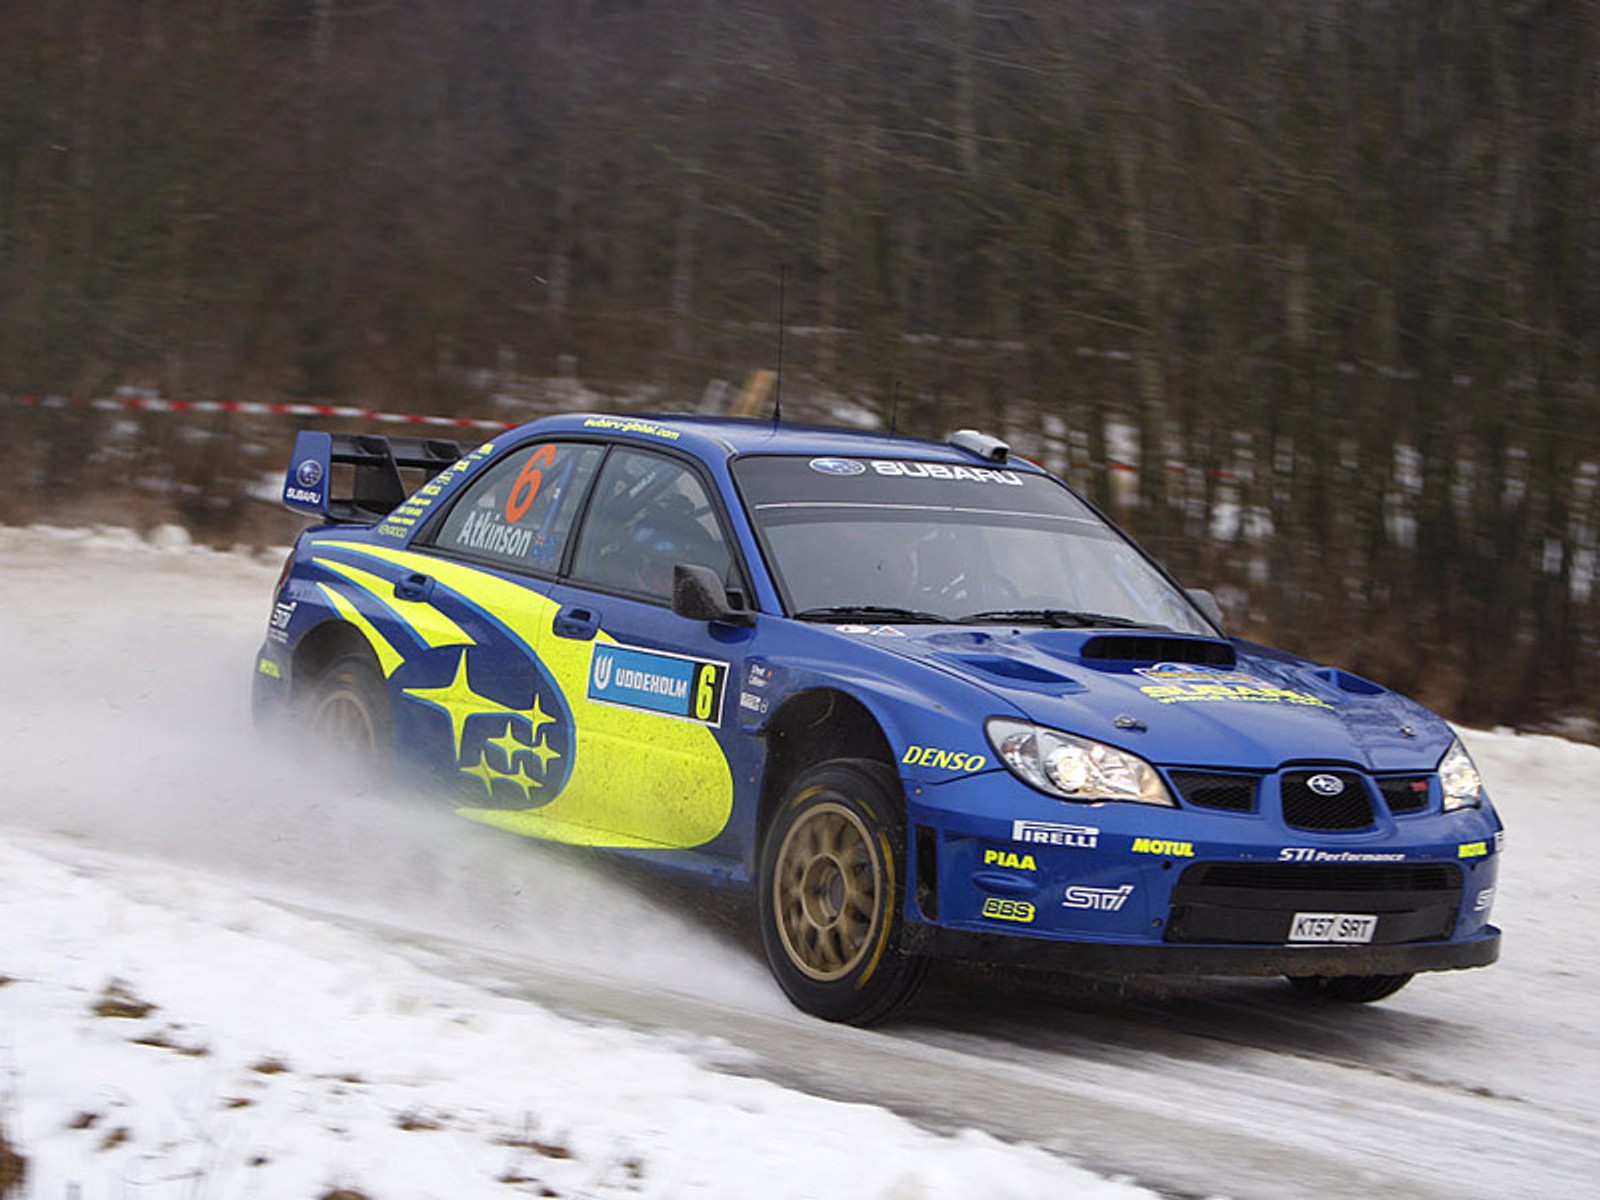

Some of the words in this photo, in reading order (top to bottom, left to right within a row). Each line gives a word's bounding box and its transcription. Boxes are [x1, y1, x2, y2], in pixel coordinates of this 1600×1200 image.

[505, 443, 557, 524] 6
[871, 460, 1023, 486] SUBARU
[286, 487, 321, 503] SUBARU
[456, 510, 532, 557] Atkinson
[616, 668, 688, 698] UDDEHOLM
[696, 665, 716, 719] 6
[902, 745, 986, 772] DENSO
[1012, 820, 1099, 848] PIRELLI
[984, 850, 1037, 871] PIAA
[1131, 838, 1195, 857] MOTUL
[1278, 847, 1316, 861] STI
[1315, 851, 1406, 862] Performance
[983, 898, 1036, 922] BBS
[1294, 917, 1334, 932] KT57
[1337, 919, 1372, 937] SRT
